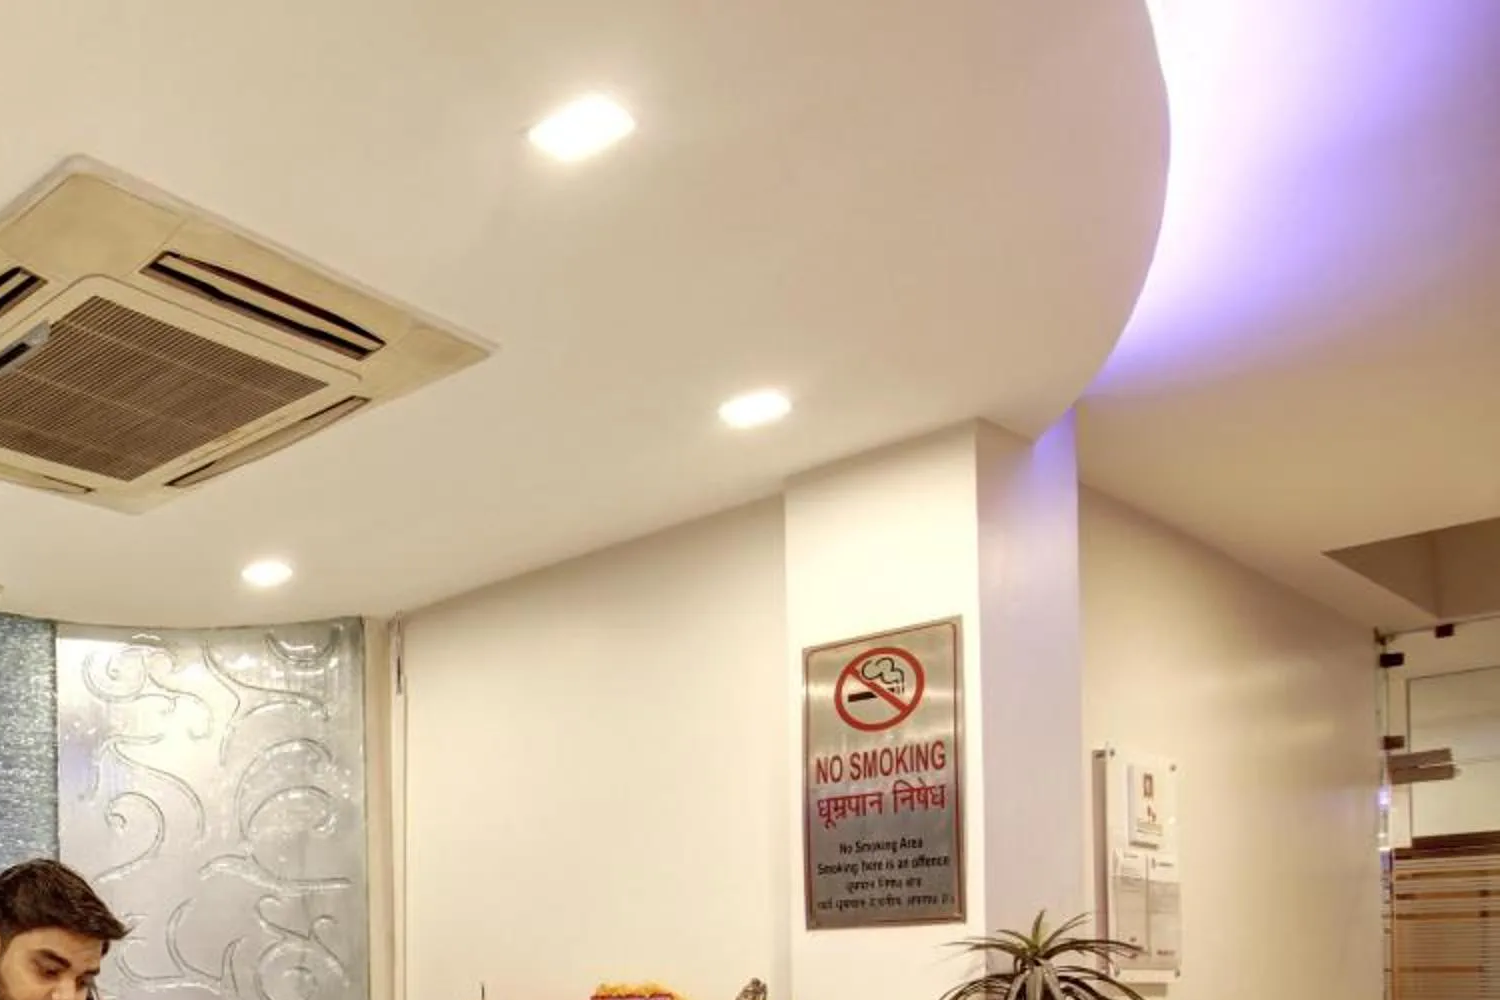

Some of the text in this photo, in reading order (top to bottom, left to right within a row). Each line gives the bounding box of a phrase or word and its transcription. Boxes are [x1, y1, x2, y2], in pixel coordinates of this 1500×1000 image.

[816, 740, 946, 784] NO SMOKING
[817, 777, 946, 829] धूम्रपान निषेध
[839, 837, 923, 854] No Smoking Area
[817, 863, 860, 876] Smoking
[862, 860, 882, 872] here
